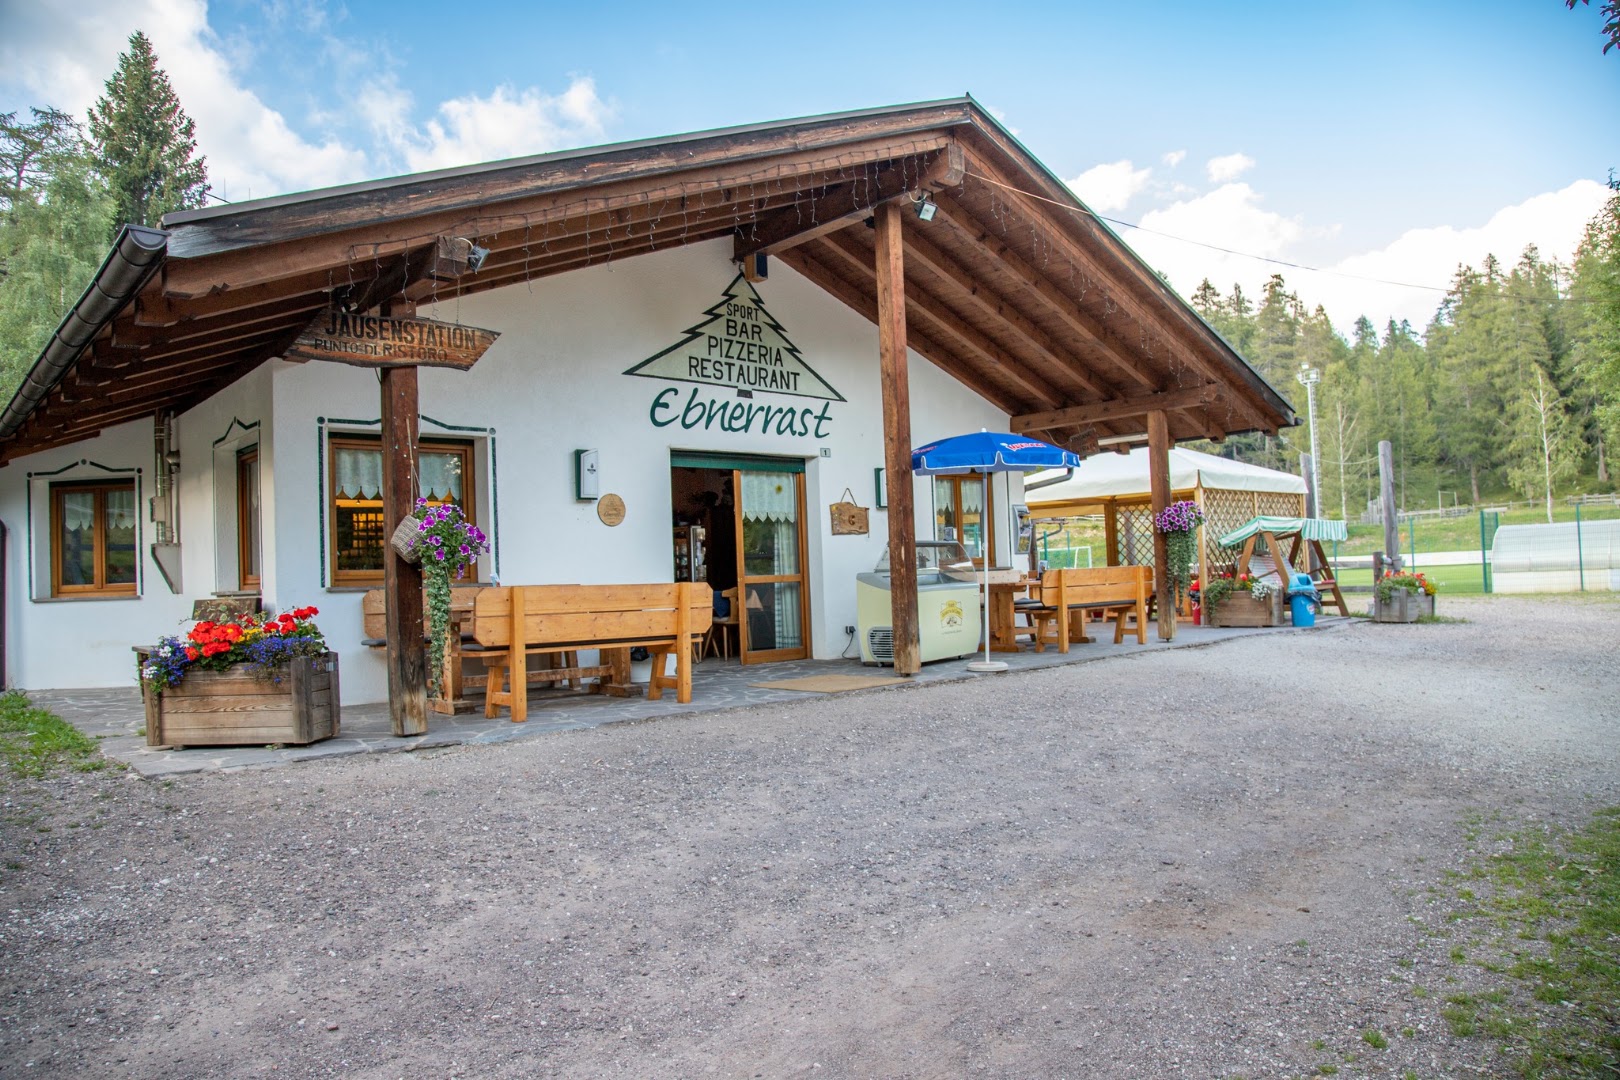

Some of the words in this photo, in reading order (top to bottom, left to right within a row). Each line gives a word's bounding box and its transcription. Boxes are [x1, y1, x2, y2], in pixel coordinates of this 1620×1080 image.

[726, 303, 760, 321] SPORT
[325, 312, 476, 350] JAUSENSTATION
[726, 319, 763, 342] BAR
[314, 338, 360, 354] PUNTO
[382, 343, 448, 362] RISTORO
[708, 335, 784, 367] PIZZERIA
[688, 356, 800, 391] RESTAURANT
[650, 387, 833, 438] Ebnerrast
